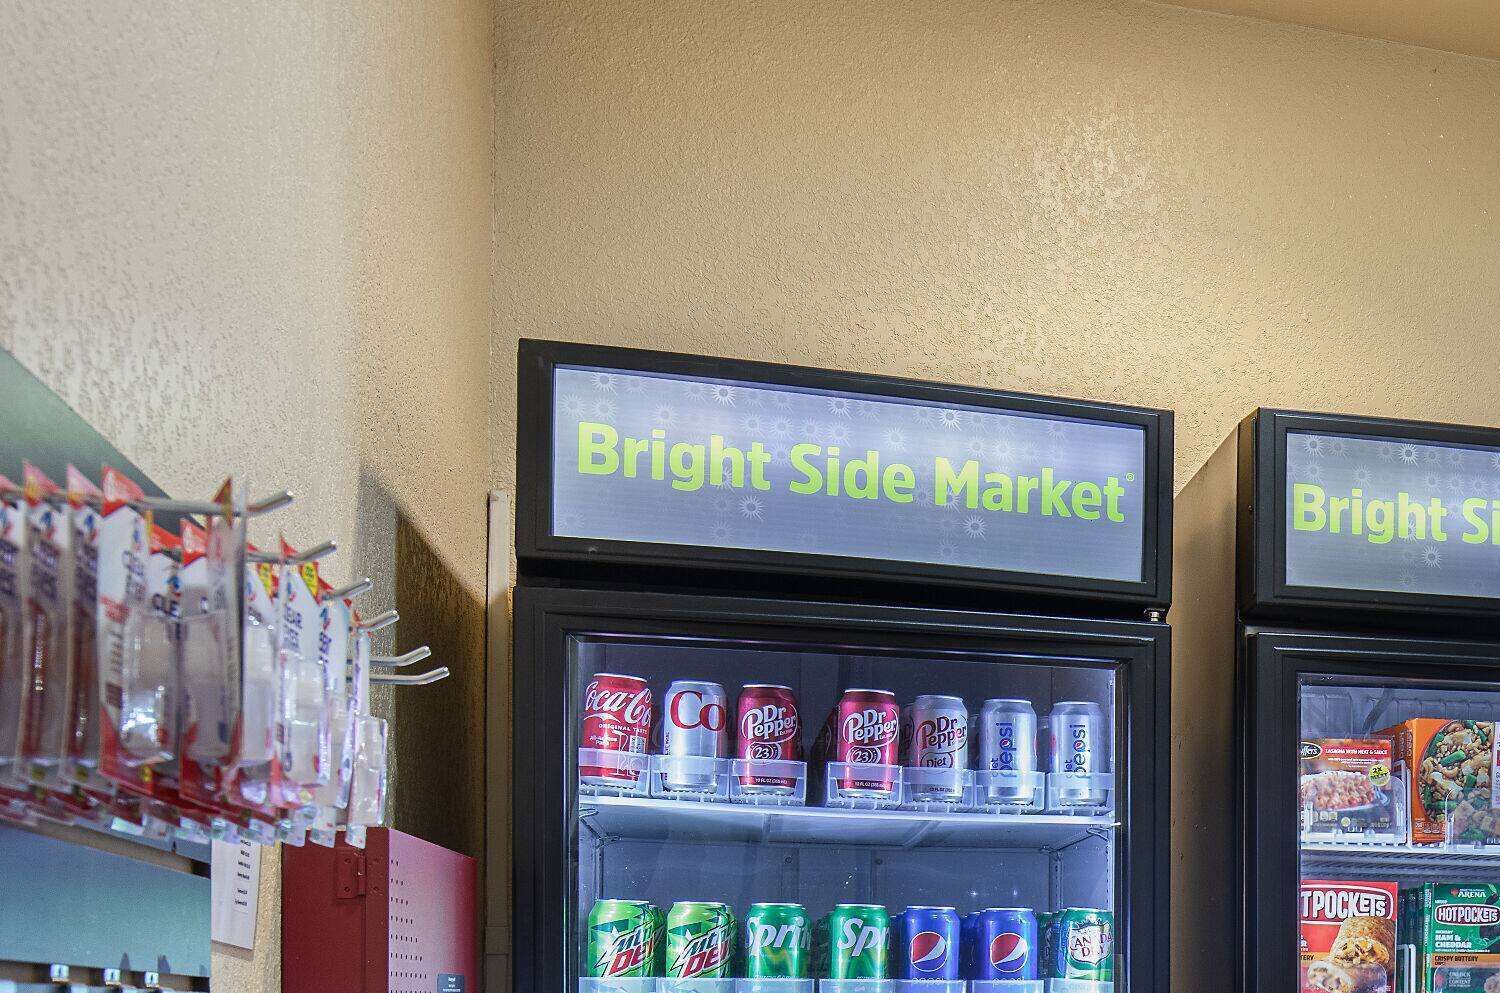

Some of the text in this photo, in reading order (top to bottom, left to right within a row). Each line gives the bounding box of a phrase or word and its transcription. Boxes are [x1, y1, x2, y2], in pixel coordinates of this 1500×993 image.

[577, 421, 1125, 523] Bright Side Market
[1293, 483, 1447, 545] Bright
[763, 704, 786, 723] Dr
[864, 709, 887, 727] Dr
[747, 708, 797, 741] Pepper
[849, 714, 898, 744] Pepper
[936, 715, 958, 732] Dr
[916, 722, 967, 750] Pepper
[756, 745, 770, 759] 23
[854, 750, 868, 762] 23
[926, 756, 947, 768] Diet
[1070, 931, 1113, 951] CANDA
[1435, 941, 1473, 949] CHEDDAR
